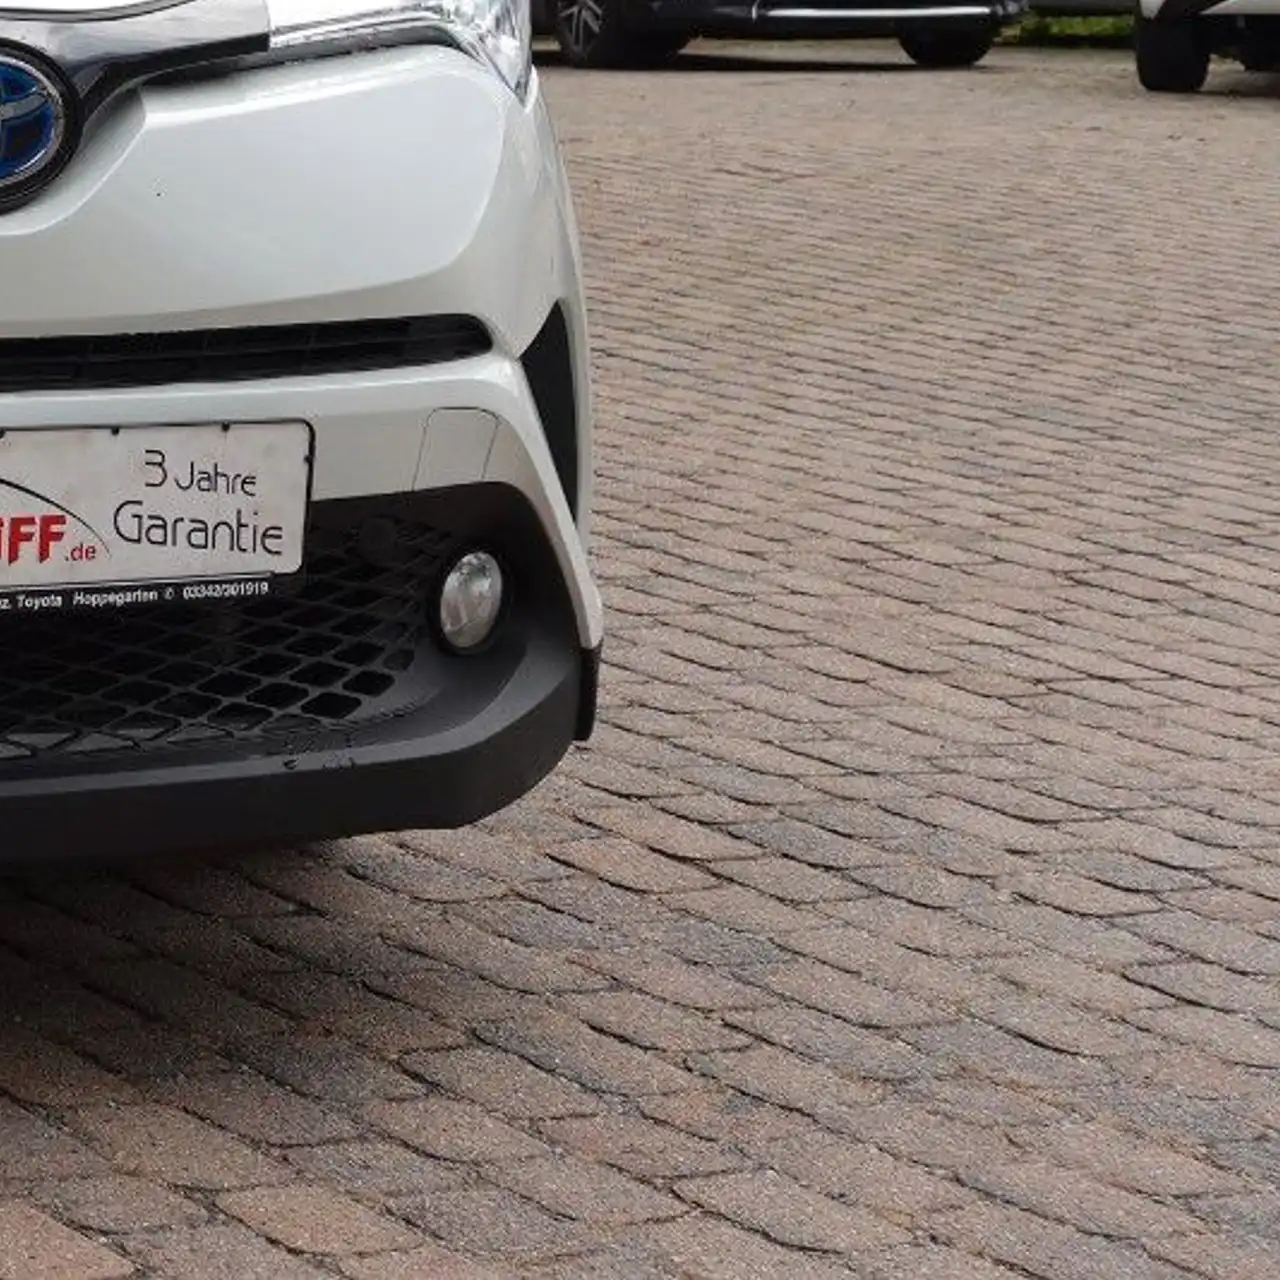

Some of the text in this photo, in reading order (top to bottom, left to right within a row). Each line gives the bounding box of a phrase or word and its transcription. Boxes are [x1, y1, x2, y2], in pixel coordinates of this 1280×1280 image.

[144, 449, 258, 497] 3 Jahre
[113, 499, 284, 556] Garantie
[16, 592, 63, 611] Toyota
[72, 588, 159, 609] Hoppegarten
